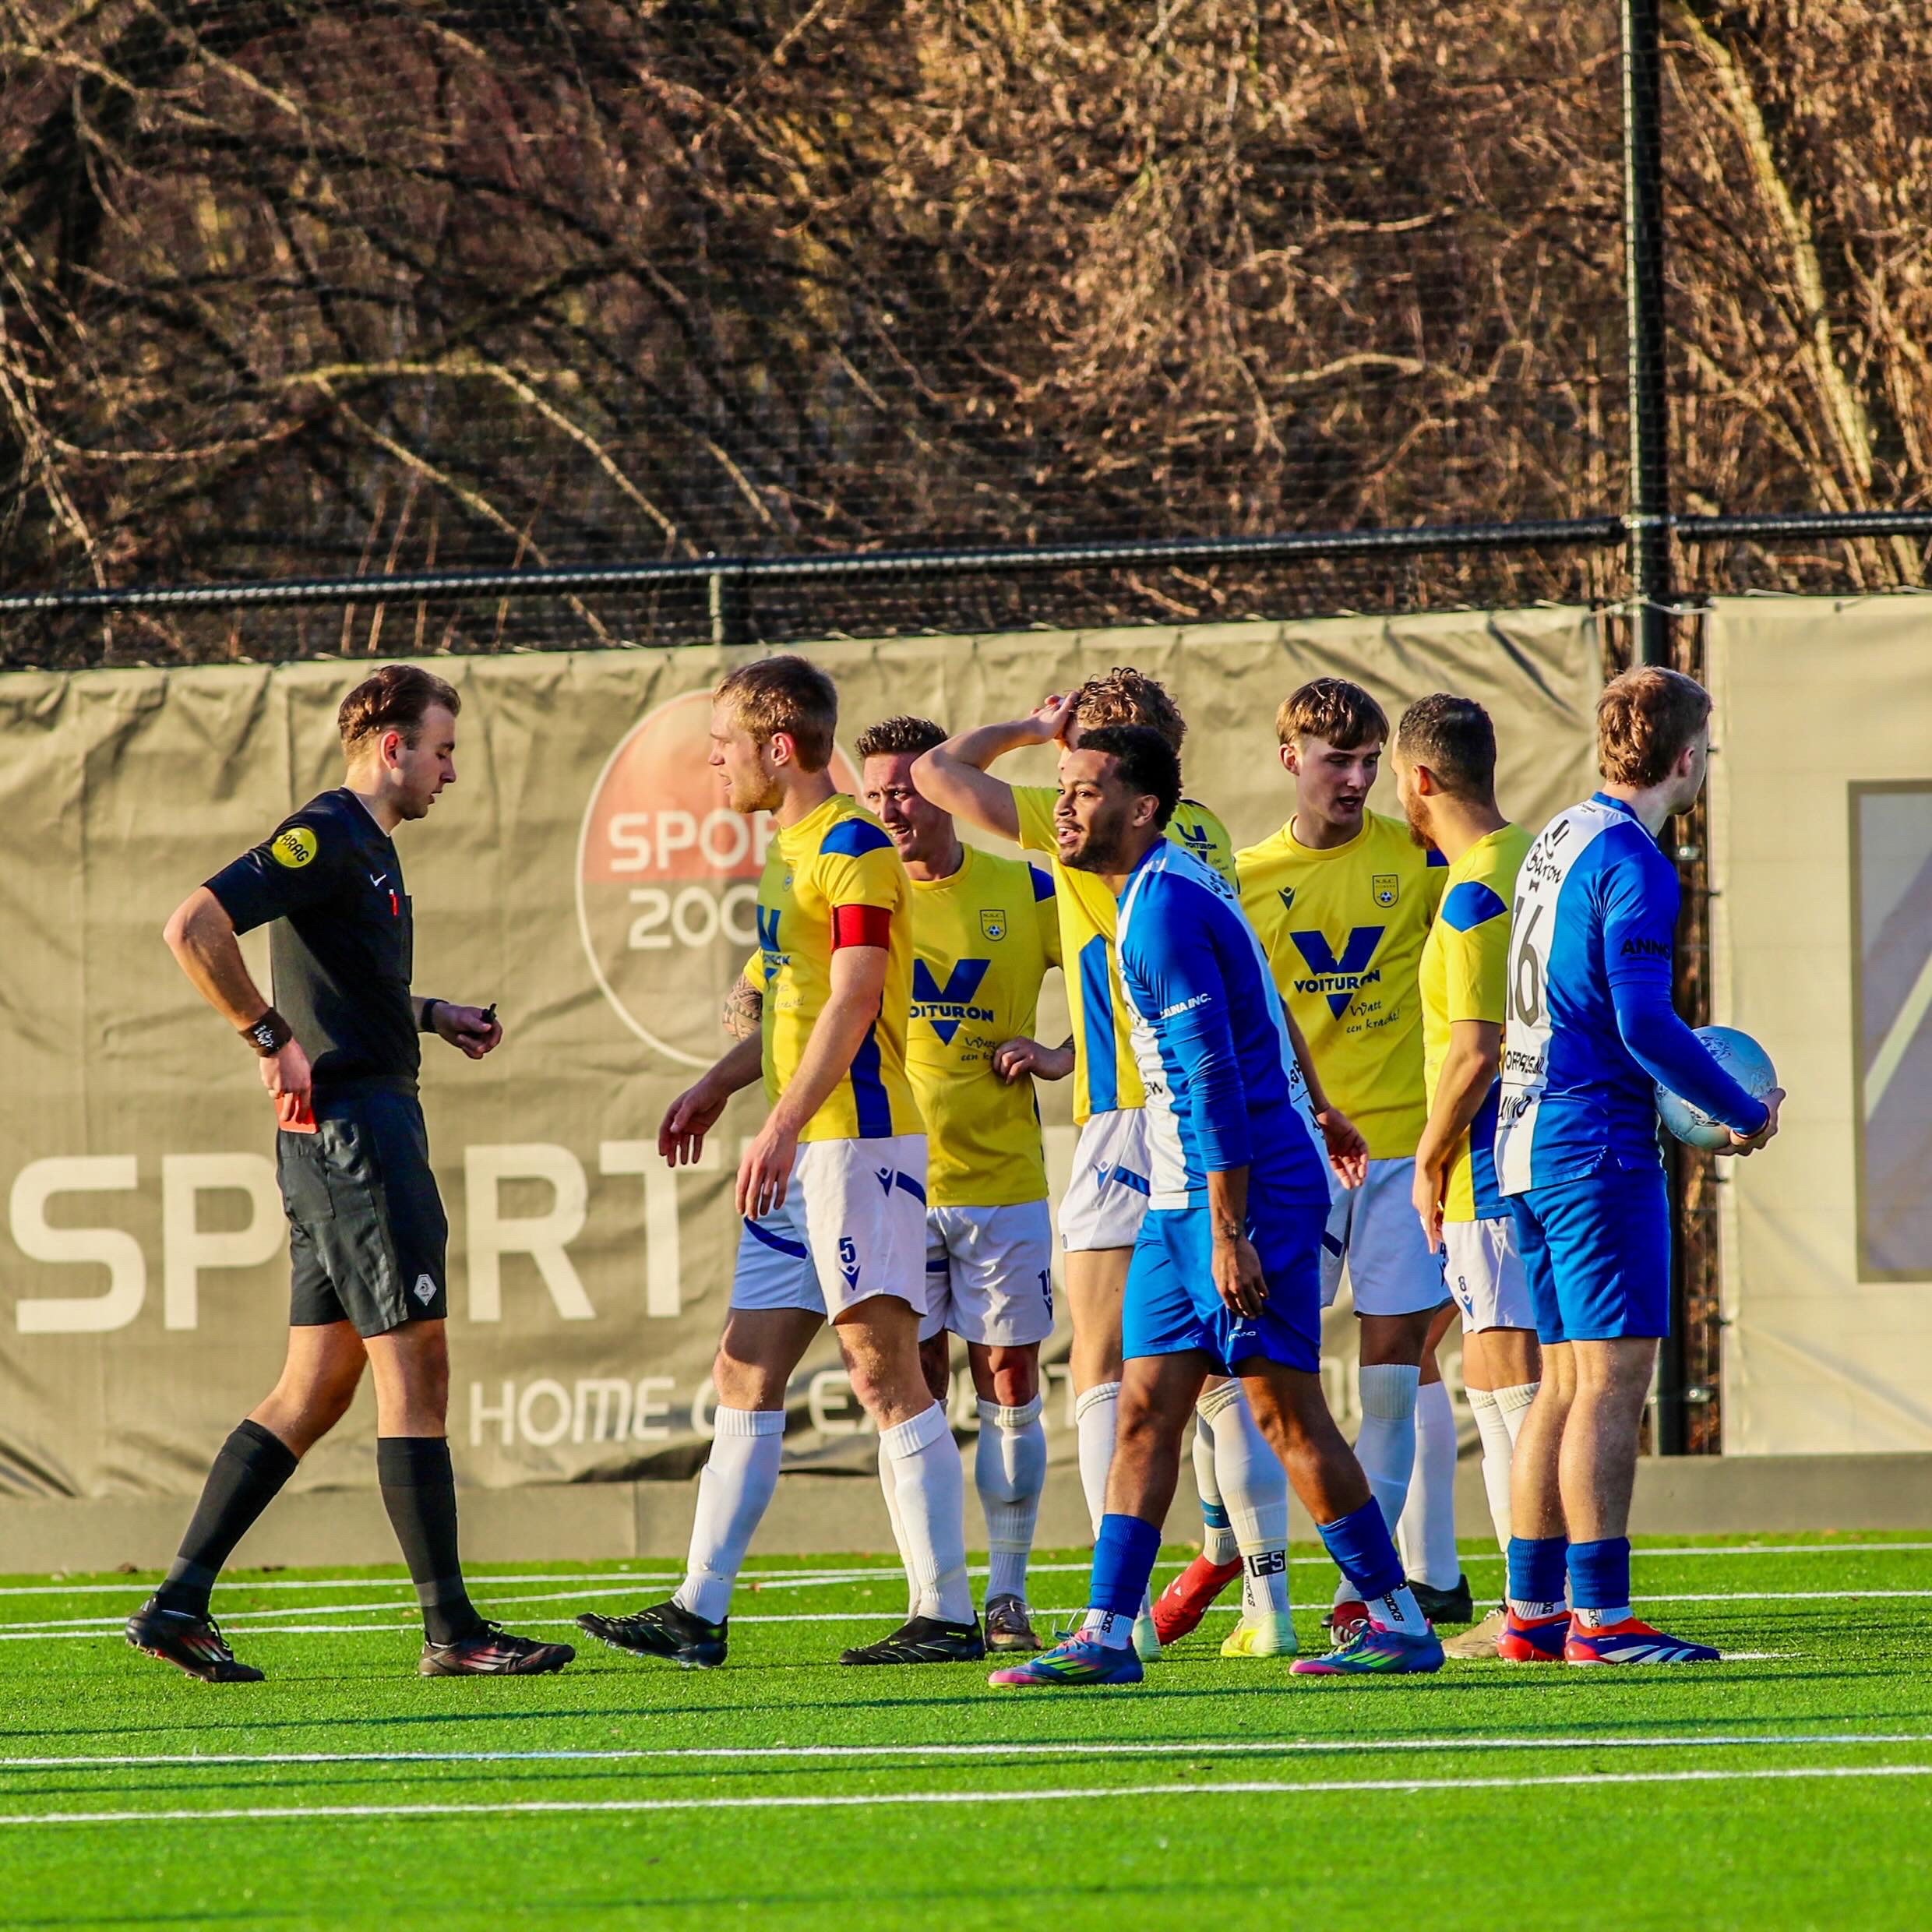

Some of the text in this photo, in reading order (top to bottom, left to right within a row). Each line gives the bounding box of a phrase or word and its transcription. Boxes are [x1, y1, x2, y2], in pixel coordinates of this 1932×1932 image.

[280, 834, 309, 862] ARAG
[1526, 842, 1562, 883] Baron
[628, 883, 760, 950] 200
[1507, 895, 1544, 1028] 16
[910, 1004, 994, 1024] OITURON
[1349, 1000, 1382, 1017] Watt
[1346, 1025, 1363, 1035] een
[8, 1138, 721, 1334] SPRT
[838, 1236, 856, 1264] 5
[1439, 1241, 1447, 1260] 4
[1458, 1275, 1467, 1292] 8
[470, 1376, 672, 1447] HOME
[1101, 1610, 1116, 1634] OCKS
